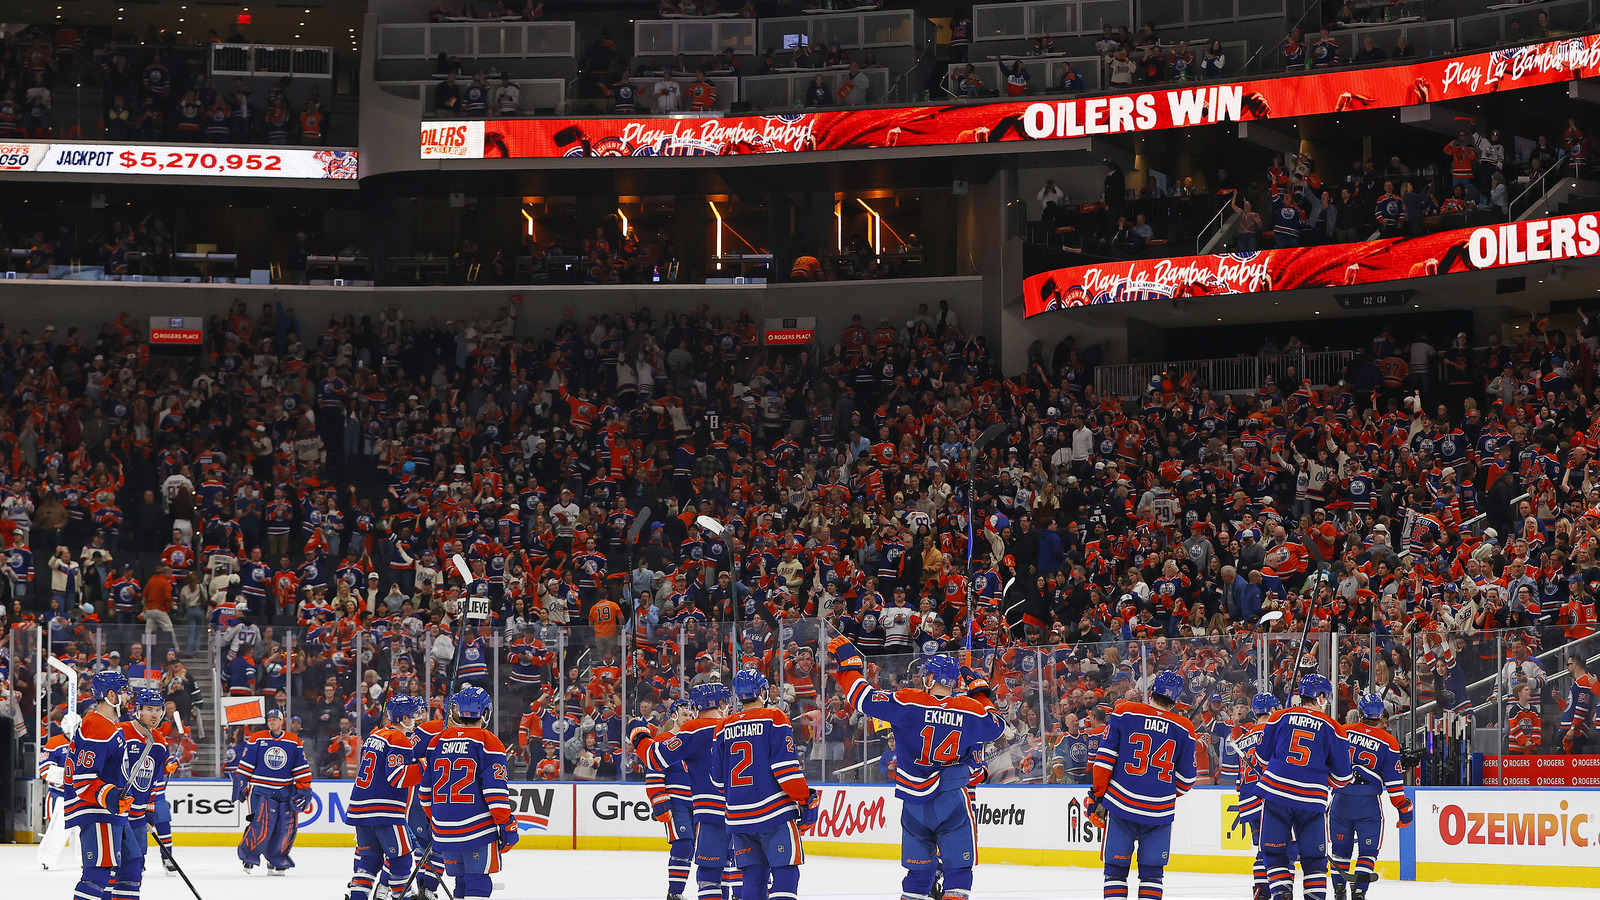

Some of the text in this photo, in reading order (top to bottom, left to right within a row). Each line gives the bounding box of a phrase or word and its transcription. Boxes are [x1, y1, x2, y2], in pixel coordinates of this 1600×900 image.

[1442, 61, 1482, 94] Play
[1484, 52, 1508, 85] La
[1569, 36, 1600, 74] bab
[1023, 85, 1242, 140] OILERS WIN
[420, 126, 466, 146] OILERS
[620, 122, 667, 151] Play
[671, 119, 696, 147] La
[761, 118, 813, 152] baby!
[57, 151, 282, 172] JACKPOT $5,270,952
[1468, 214, 1600, 269] OILERS
[1081, 268, 1126, 299] Play
[1126, 264, 1149, 293] La
[1218, 256, 1271, 293] baby!
[597, 606, 611, 622] 19
[239, 632, 255, 645] 97
[925, 710, 963, 727] EKHOLM
[1144, 719, 1169, 734] DACH
[1288, 714, 1324, 732] MURPHY
[724, 723, 763, 742] OUCHARD
[441, 740, 470, 755] SAVOIE
[664, 736, 682, 751] 0
[785, 736, 796, 753] 2
[914, 725, 962, 767] 14
[1286, 730, 1316, 767] 5
[1347, 733, 1381, 752] KAPANEN
[76, 750, 96, 769] 96
[730, 741, 754, 787] 2
[1124, 732, 1177, 783] 34
[1483, 759, 1499, 767] GERS
[1509, 759, 1530, 768] ROGERS
[1543, 759, 1565, 768] ROGERS
[1578, 759, 1600, 768] ROGERS
[356, 751, 377, 790] 3
[432, 757, 478, 804] 22
[1483, 777, 1499, 786] GERS
[1509, 777, 1530, 786] ROGERS
[1543, 777, 1565, 786] ROGERS
[1578, 777, 1600, 786] ROGERS
[172, 793, 235, 815] rise
[591, 791, 657, 822] Gre
[975, 803, 1026, 826] lberta
[697, 855, 721, 863] BAUER
[735, 848, 752, 856] CCM
